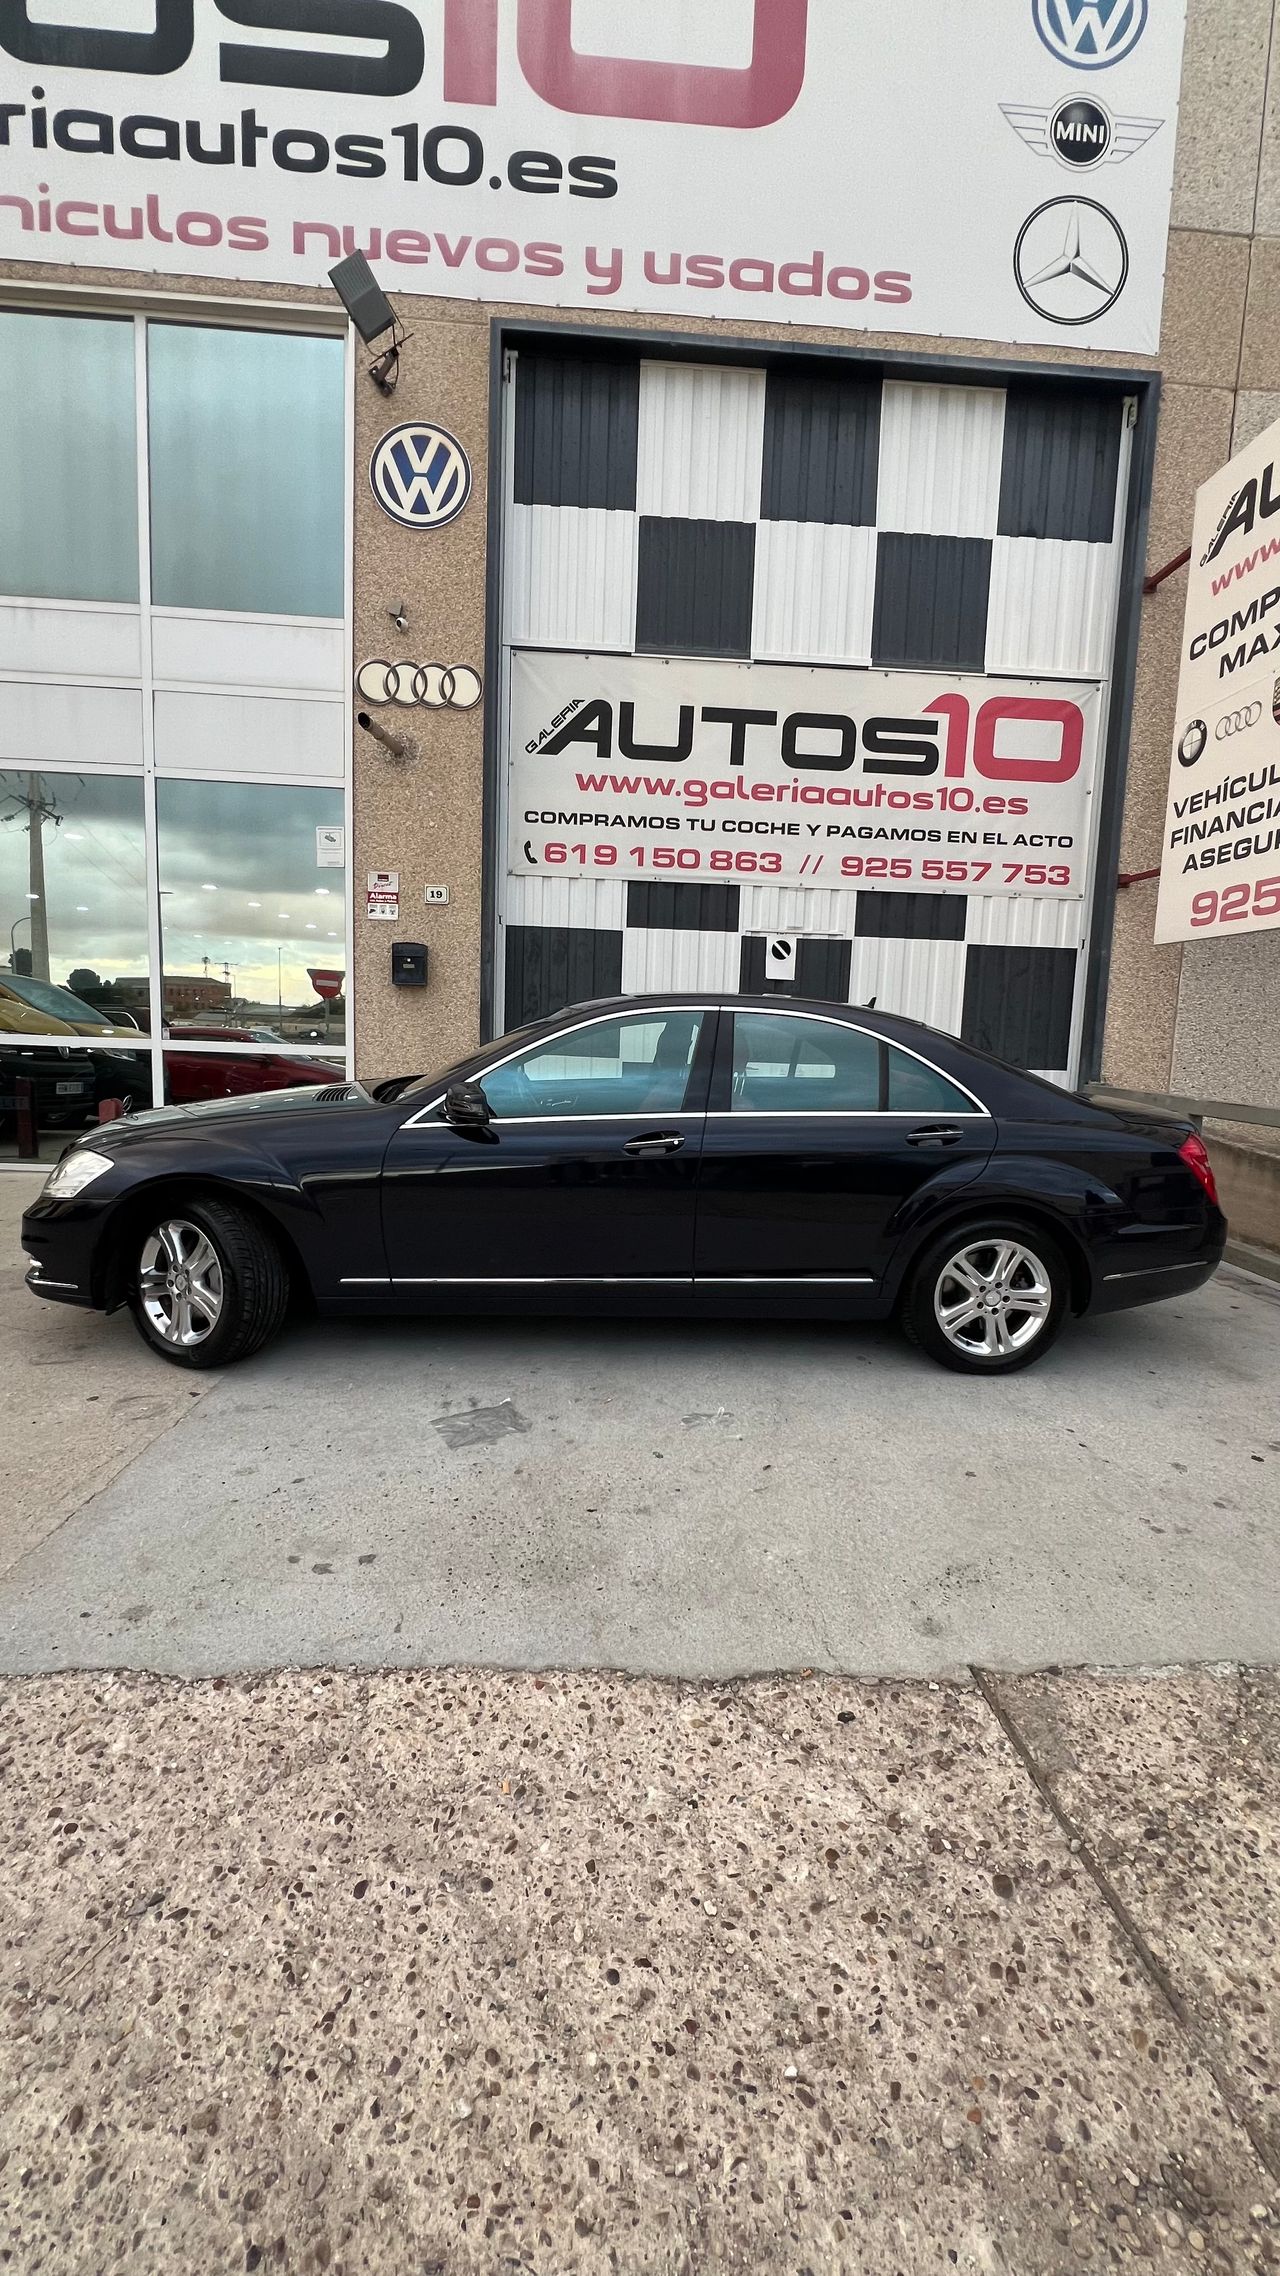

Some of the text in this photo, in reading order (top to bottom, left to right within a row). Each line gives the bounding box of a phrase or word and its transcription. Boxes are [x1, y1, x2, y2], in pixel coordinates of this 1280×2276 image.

[1056, 121, 1105, 143] MINI
[292, 221, 564, 278] nuevos
[585, 246, 622, 295] y
[643, 250, 912, 305] usados
[525, 699, 586, 754] GALERIA
[535, 692, 1084, 783] AUTOS10
[575, 773, 1029, 816] www.galeriaautos10.es
[524, 811, 1073, 848] COMPRAMOS TU COCHE Y PAGAMOS EN EL ACTO
[544, 843, 618, 866] 619
[630, 847, 701, 869] 150
[710, 850, 782, 873] 863
[841, 856, 912, 878] 925
[921, 860, 992, 882] 557
[1002, 864, 1071, 885] 753
[369, 892, 397, 900] Alarma
[430, 890, 443, 899] 19
[1190, 876, 1280, 927] 925
